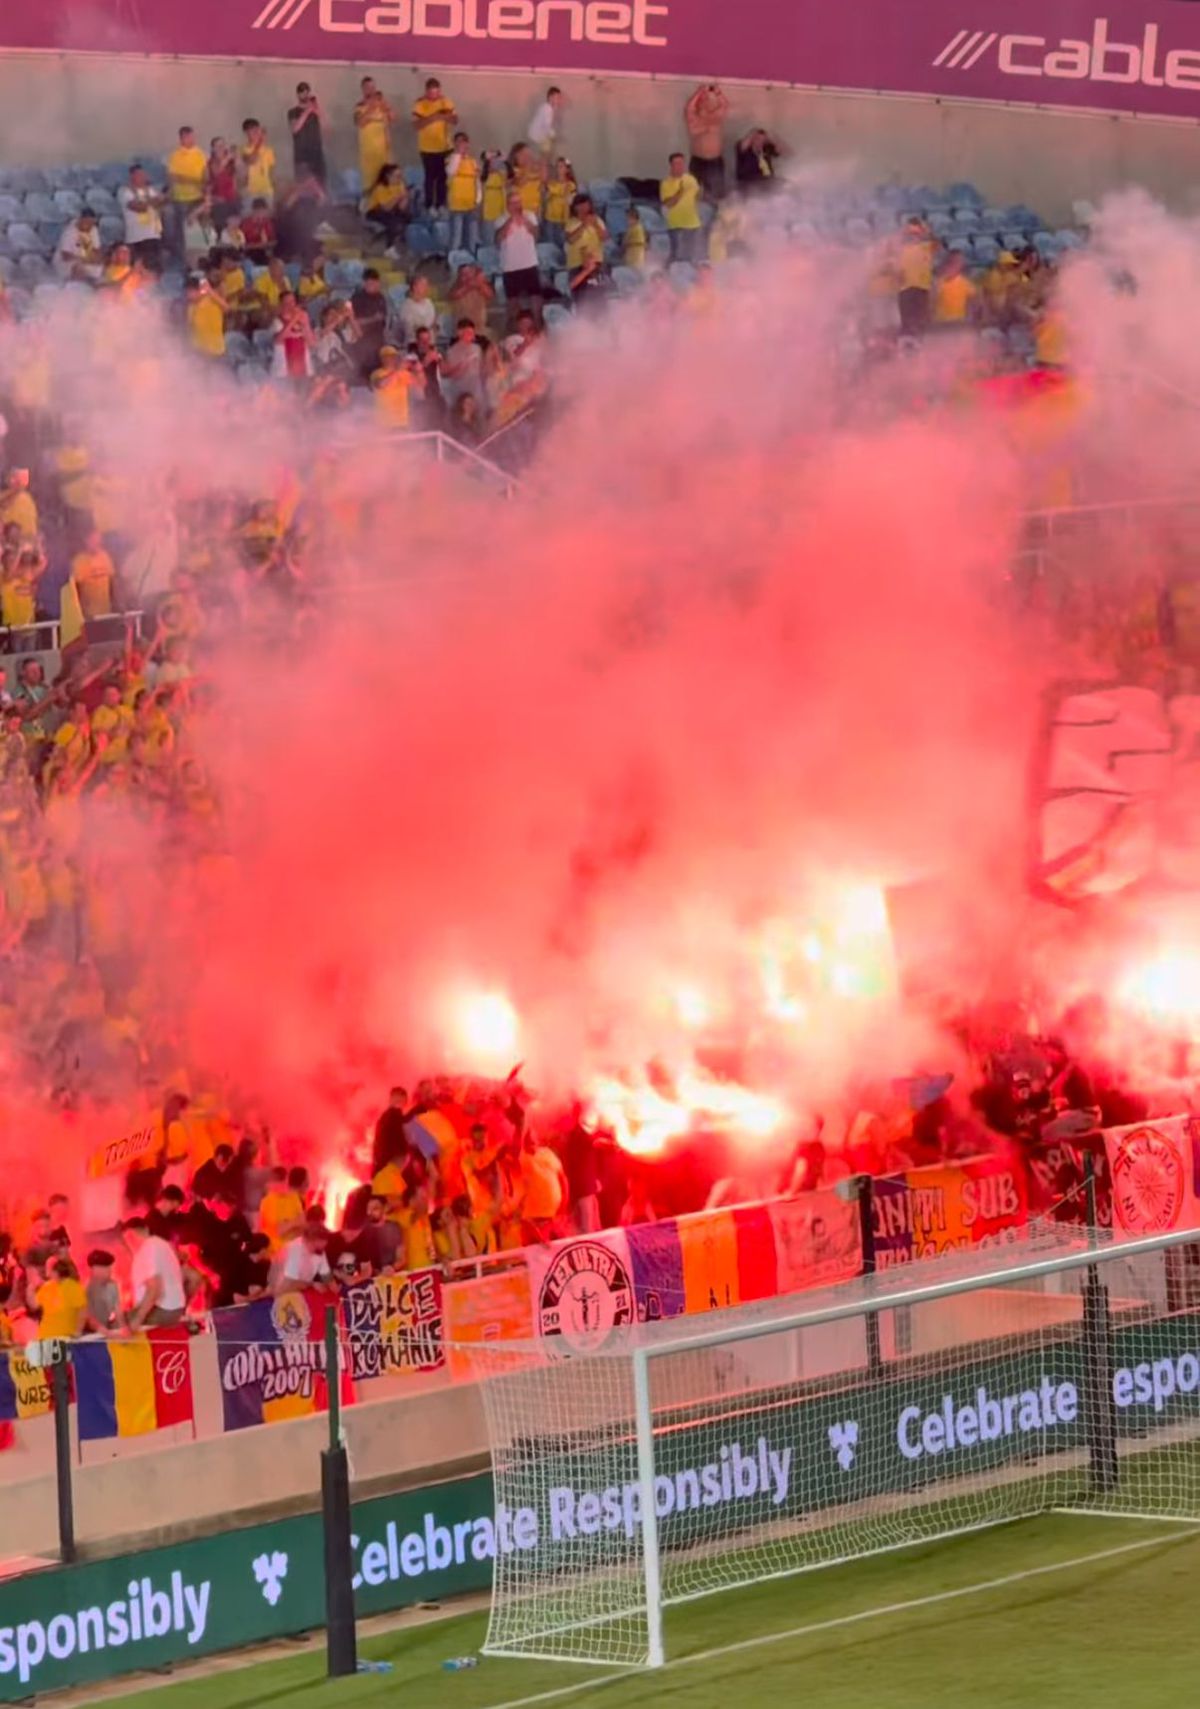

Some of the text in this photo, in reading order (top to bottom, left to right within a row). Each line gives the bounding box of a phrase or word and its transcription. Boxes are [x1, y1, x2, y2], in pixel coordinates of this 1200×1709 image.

[318, 0, 669, 46] cablenet
[961, 1171, 1019, 1226] SUB
[350, 1273, 435, 1330] DULCE
[543, 1312, 560, 1327] 20
[263, 1365, 312, 1399] 2007
[896, 1375, 1078, 1459] Celebrate
[548, 1436, 793, 1542] Responsibly
